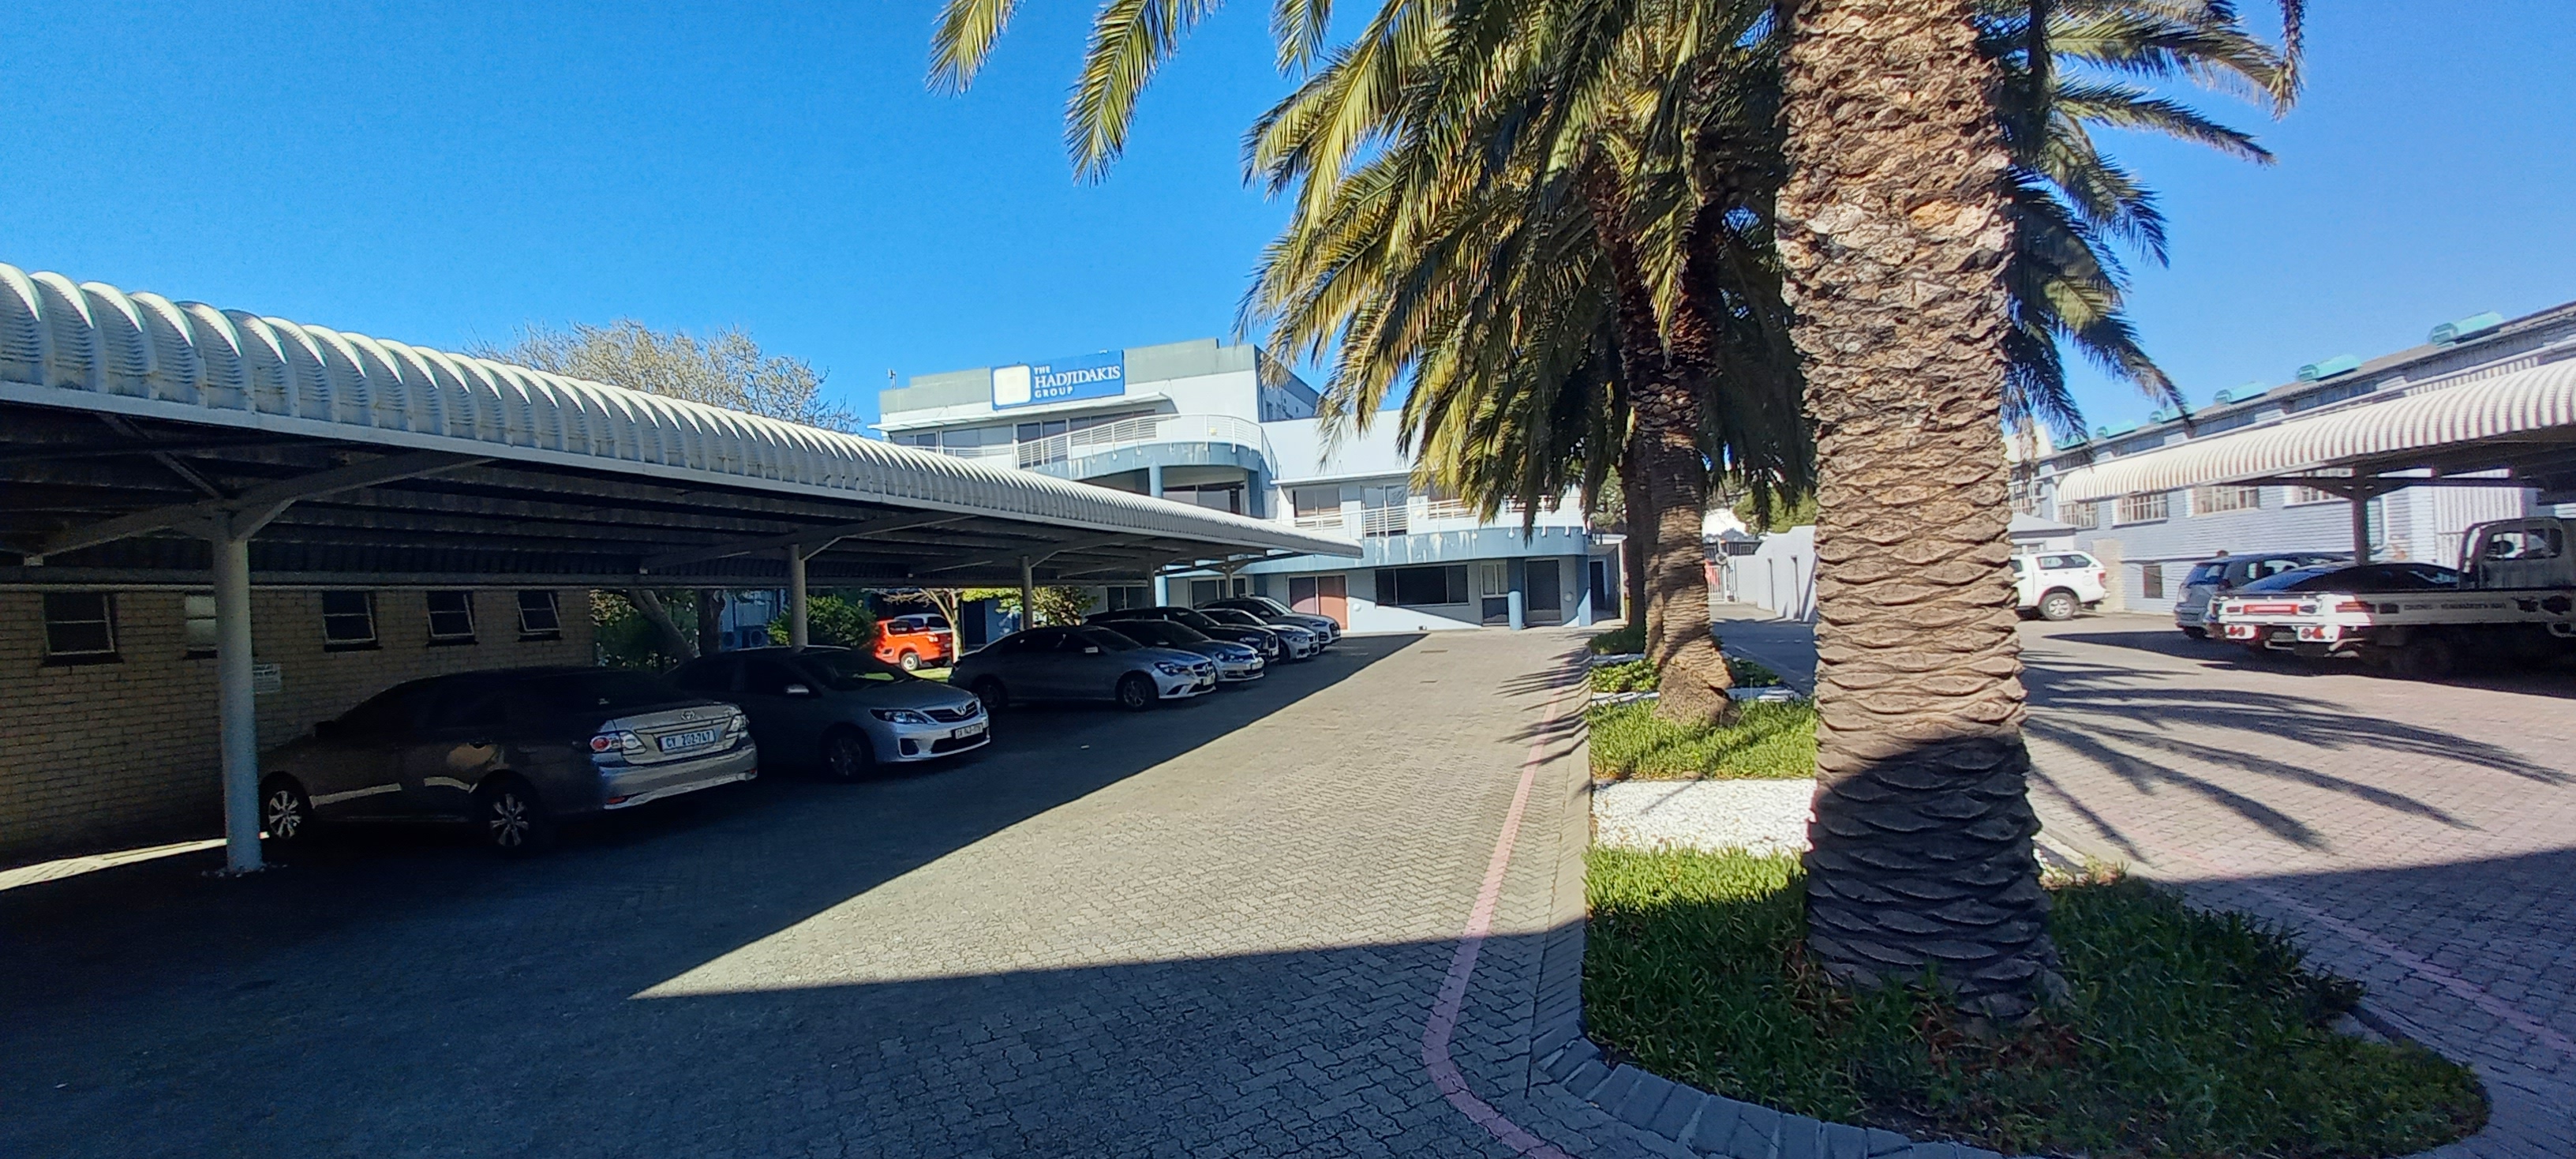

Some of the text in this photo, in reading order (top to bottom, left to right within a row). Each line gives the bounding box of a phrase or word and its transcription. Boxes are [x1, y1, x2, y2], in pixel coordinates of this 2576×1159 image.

[1034, 366, 1050, 375] THE
[1035, 366, 1121, 388] HADJIDAKIS
[1035, 386, 1073, 398] GROUP
